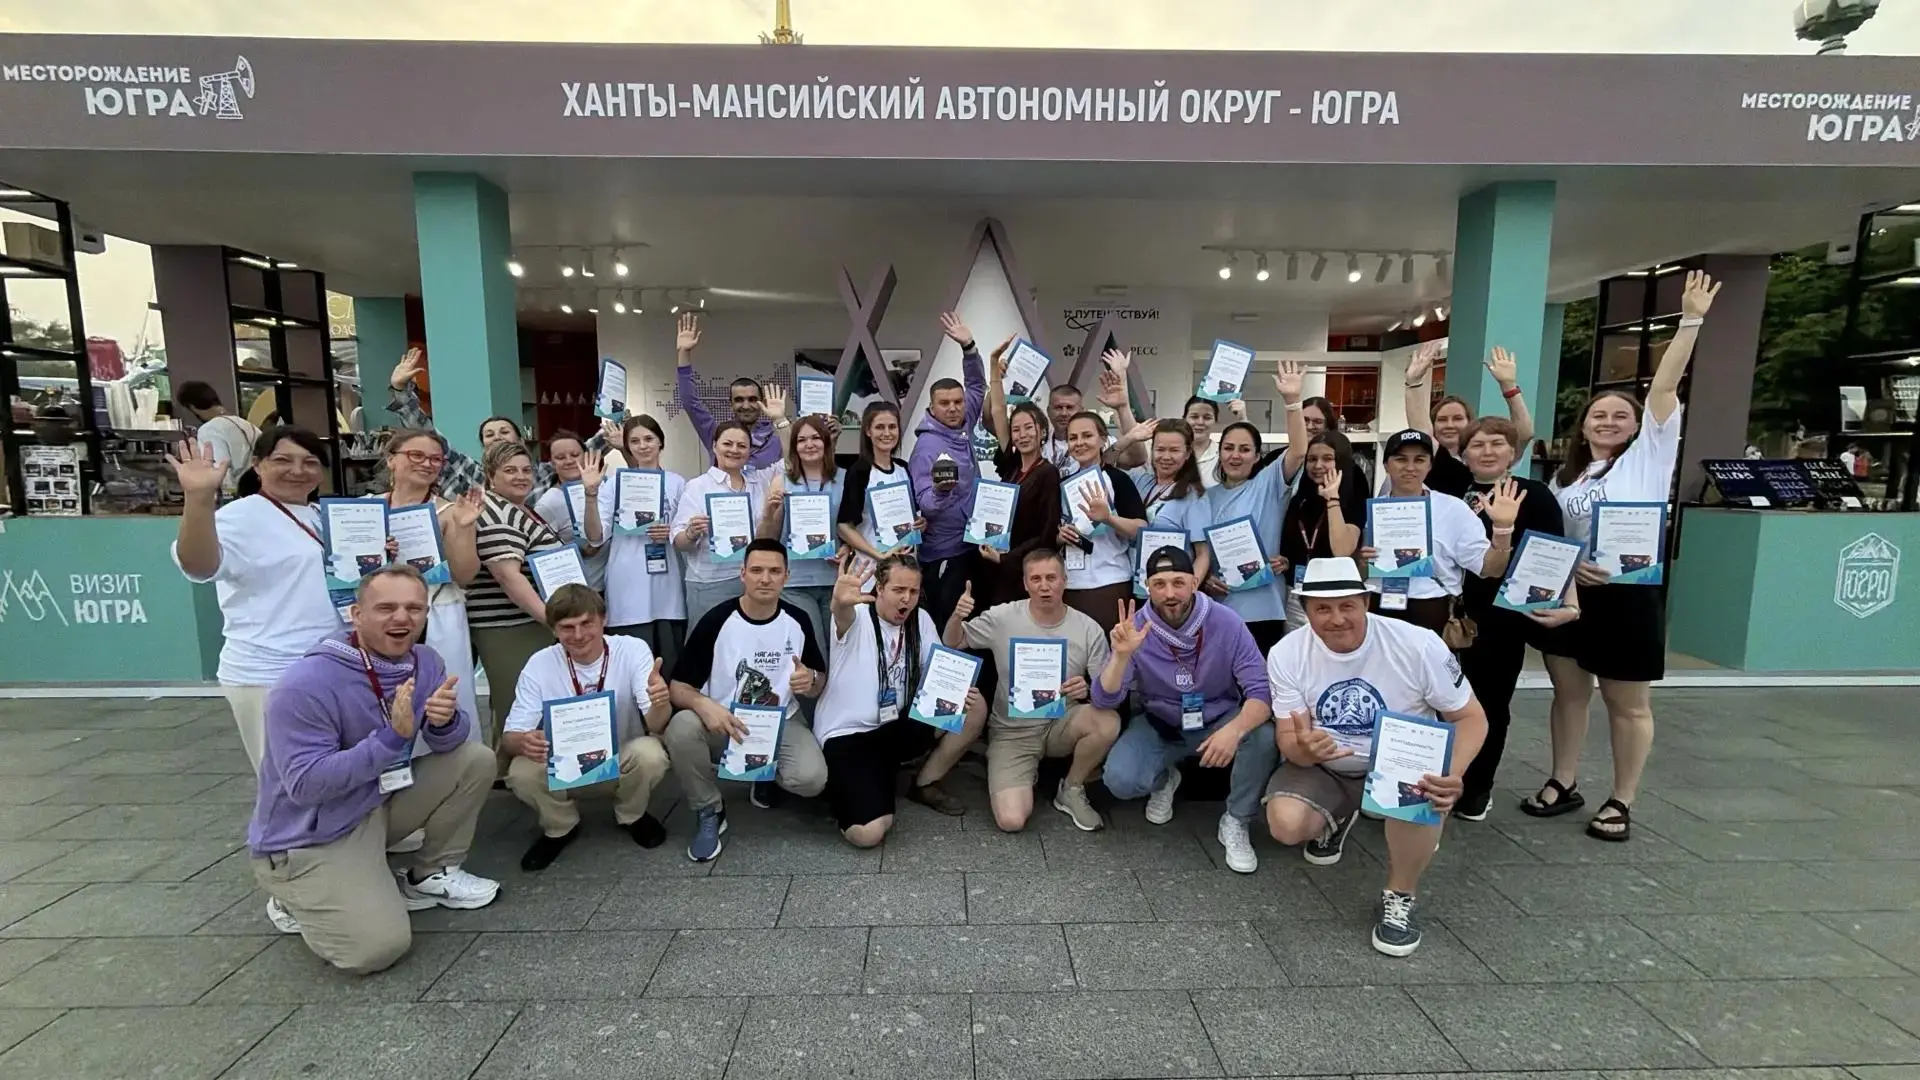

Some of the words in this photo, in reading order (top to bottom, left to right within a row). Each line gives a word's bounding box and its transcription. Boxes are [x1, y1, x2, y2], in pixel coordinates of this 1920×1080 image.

[3, 65, 191, 84] МЕСТОРОЖДЕНИЕ
[85, 88, 196, 117] ЮГРА
[561, 75, 925, 121] ХАНТЫ-МАНСИЙСКИЙ
[935, 79, 1170, 124] АВТОНОМНЫЙ
[1179, 88, 1283, 125] ОКРУГ
[1311, 90, 1400, 125] ЮГРА
[1741, 92, 1911, 111] МЕСТОРОЖДЕНИЕ
[1807, 114, 1903, 142] ЮГРА
[1075, 306, 1160, 319] ПУТЕСТВУЙ!
[69, 574, 142, 594] ВИЗИТ
[74, 599, 148, 623] ЮГРА
